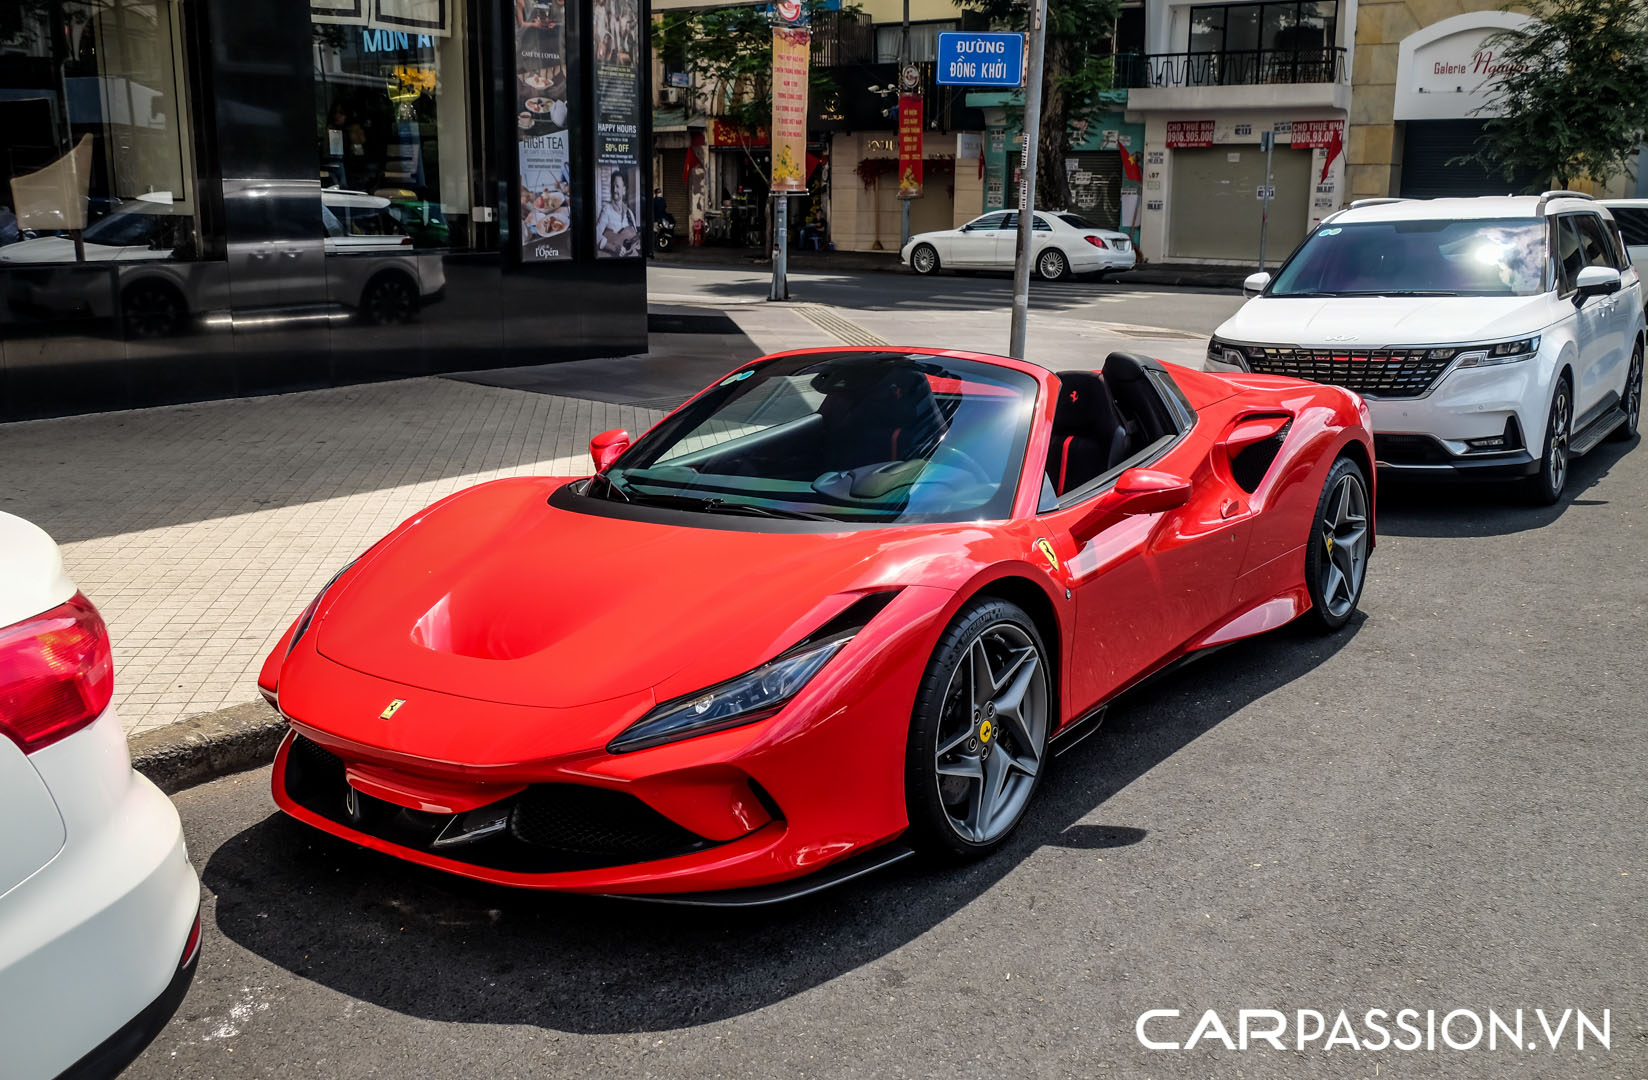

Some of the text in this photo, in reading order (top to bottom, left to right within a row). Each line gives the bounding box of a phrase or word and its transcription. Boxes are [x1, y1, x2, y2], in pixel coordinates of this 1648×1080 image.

[956, 38, 1005, 54] ĐƯỜNG
[950, 55, 1007, 79] ĐỒNG KHỞI
[1434, 62, 1466, 74] Galerie
[597, 123, 637, 134] HAPPY HOURS
[1168, 123, 1181, 132] CHO
[1292, 123, 1308, 132] CHO
[523, 135, 564, 150] HIGH TEA
[605, 143, 630, 153] 50% OFF
[535, 247, 559, 259] l'Opéra
